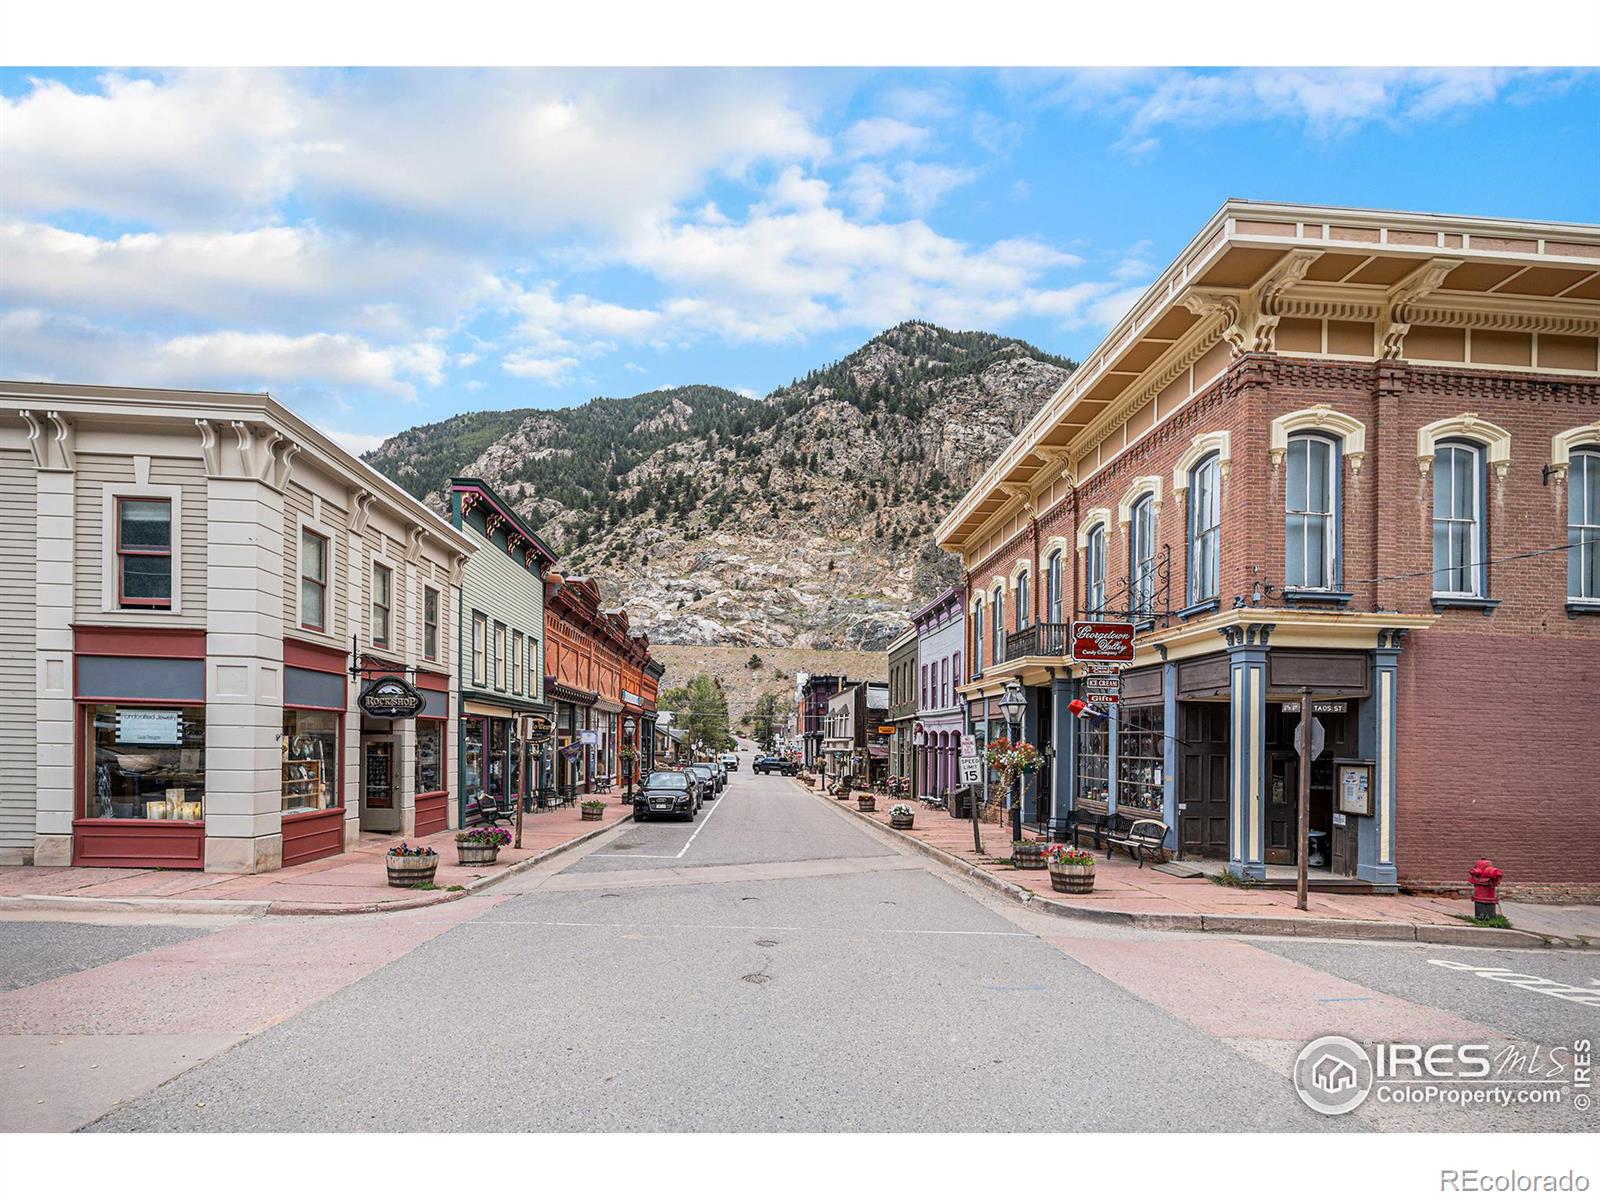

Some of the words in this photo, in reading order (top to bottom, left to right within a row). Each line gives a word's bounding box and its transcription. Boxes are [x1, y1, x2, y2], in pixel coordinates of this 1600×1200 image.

[1076, 625, 1130, 643] Georgetown
[1098, 639, 1127, 654] Valley
[965, 770, 978, 781] 15
